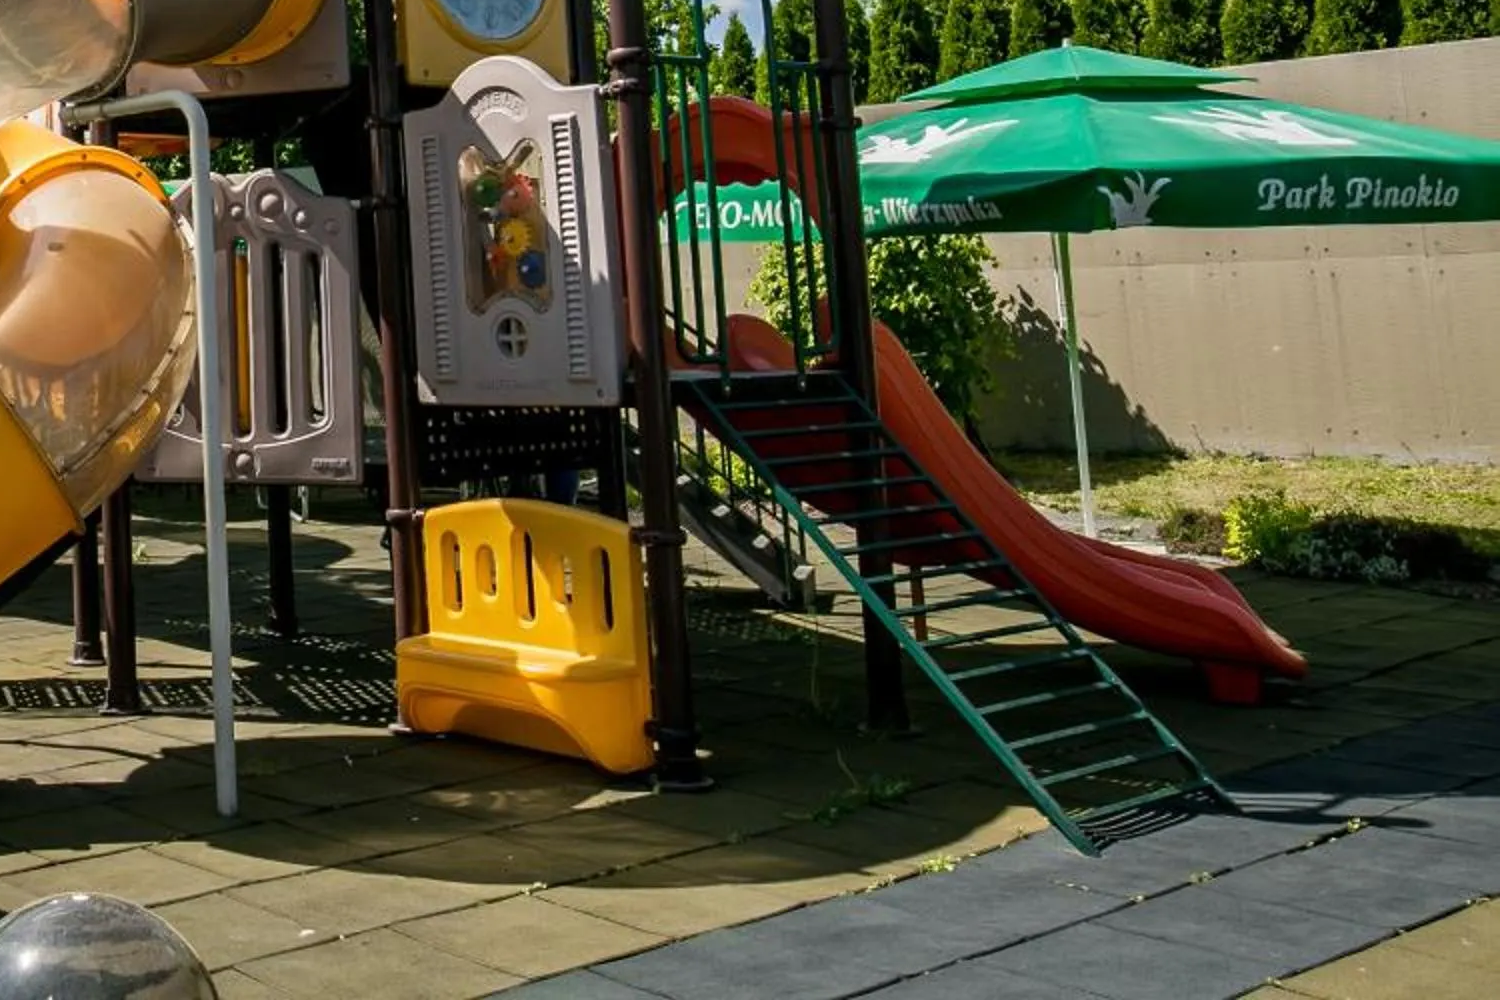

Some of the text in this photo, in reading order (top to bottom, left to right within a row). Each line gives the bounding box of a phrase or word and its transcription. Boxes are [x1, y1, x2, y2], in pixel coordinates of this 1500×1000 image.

[1257, 174, 1459, 210] Park Pinokio
[863, 195, 1003, 227] a-Wierzynka
